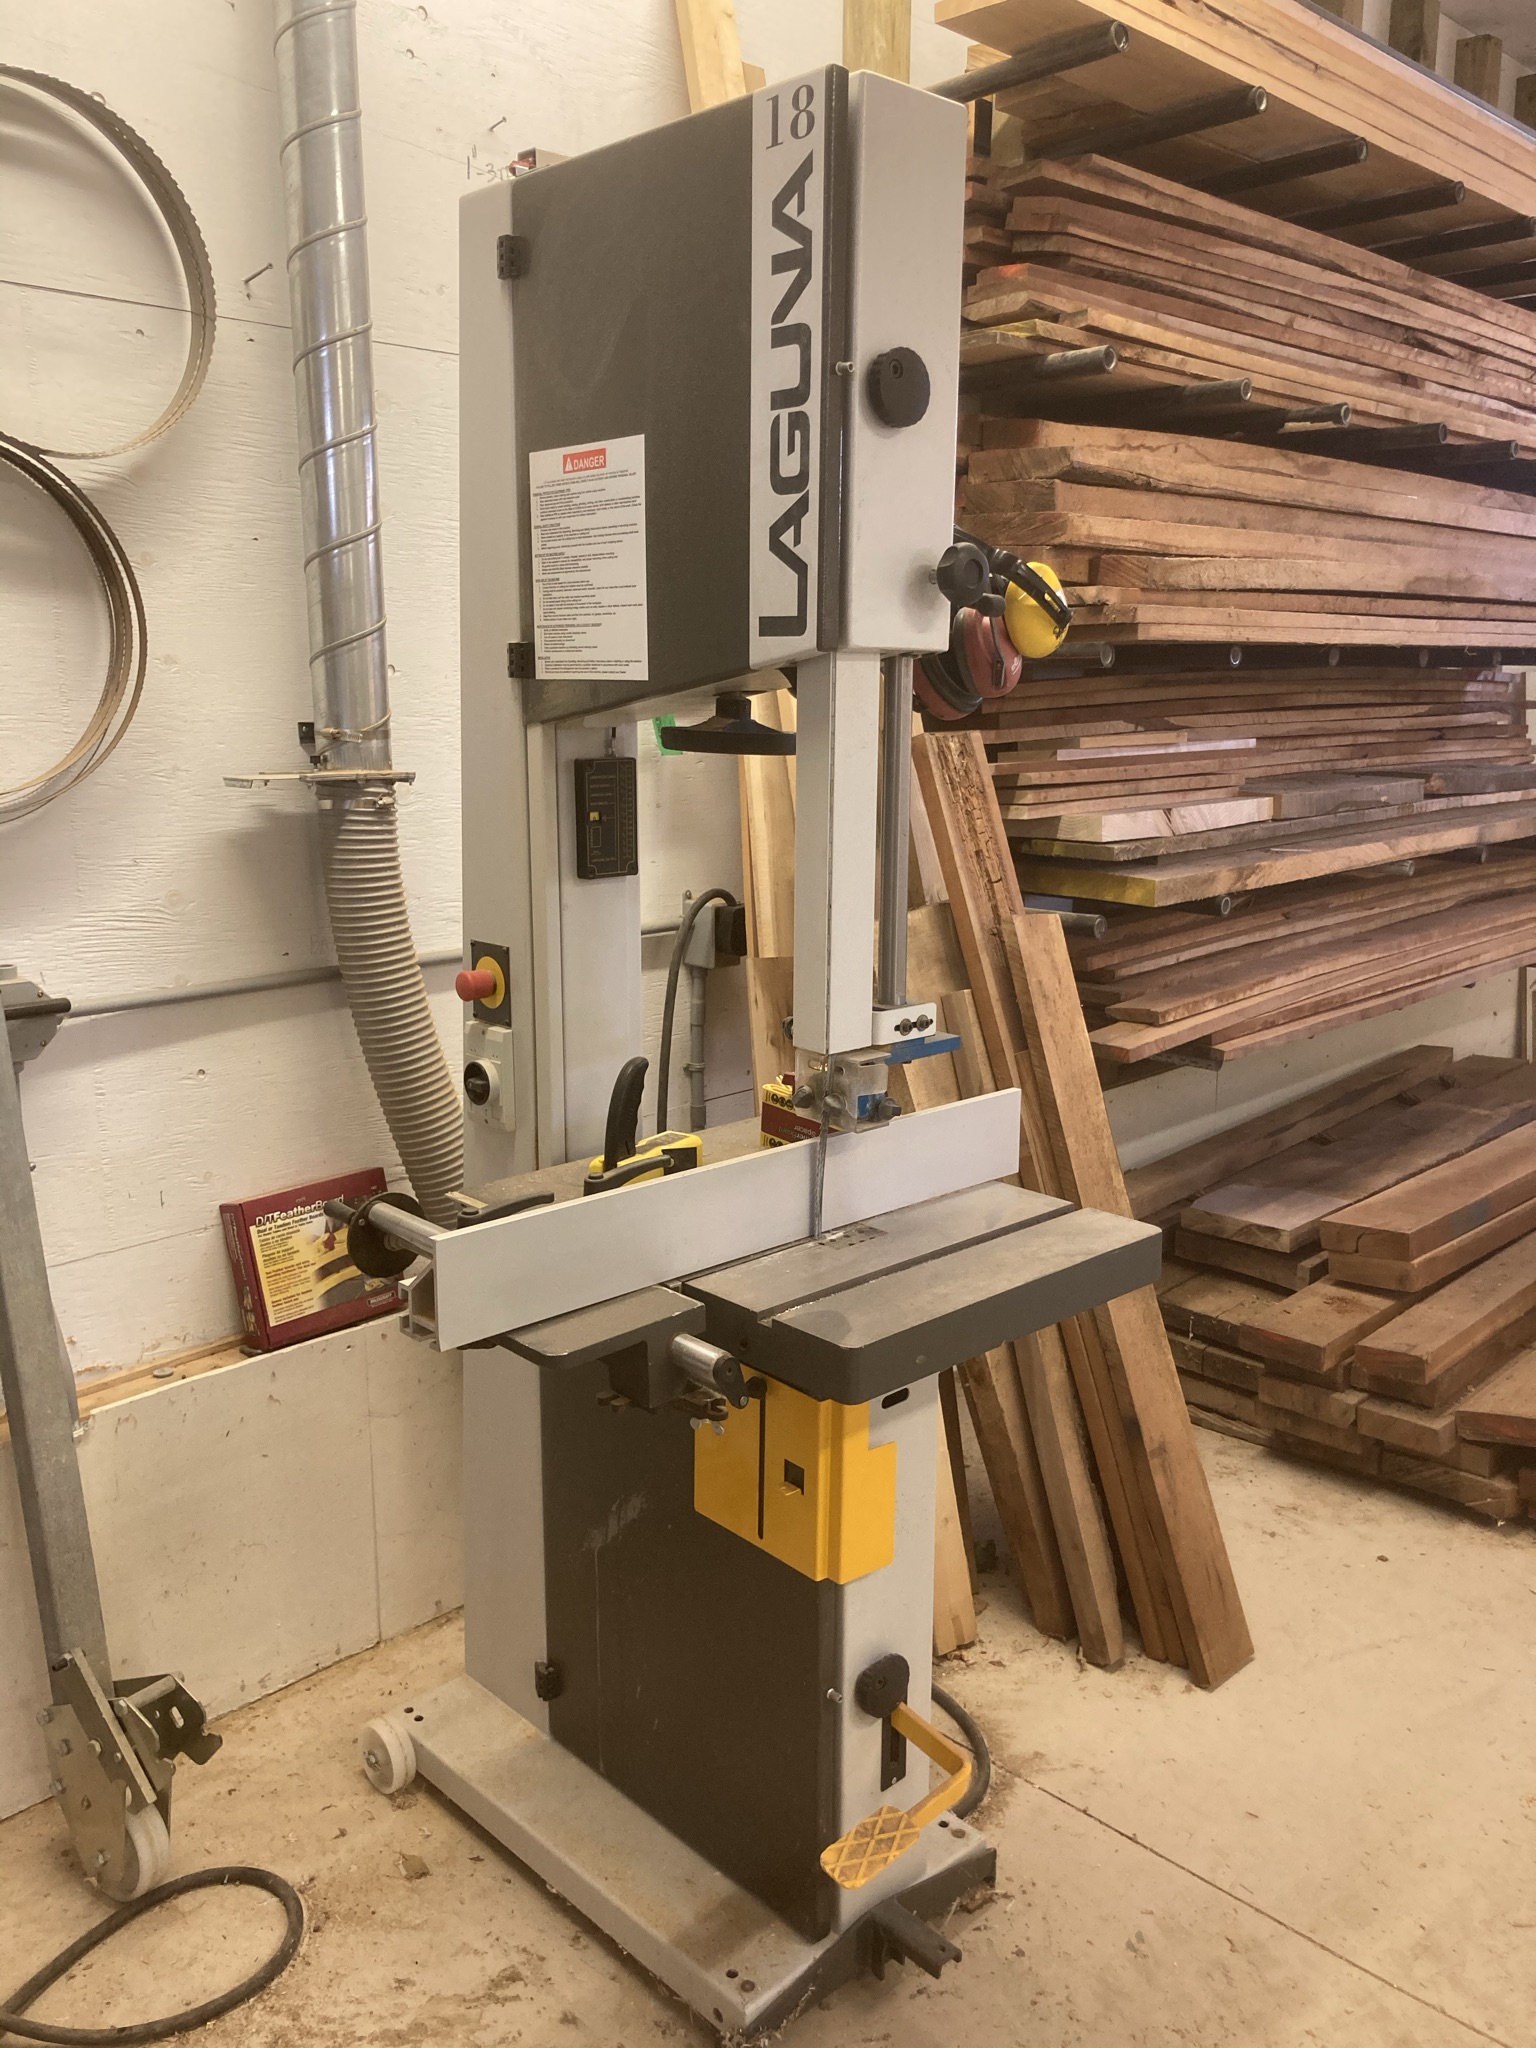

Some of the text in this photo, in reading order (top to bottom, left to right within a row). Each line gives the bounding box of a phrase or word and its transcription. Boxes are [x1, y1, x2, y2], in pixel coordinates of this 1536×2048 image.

[765, 84, 815, 150] 18
[758, 148, 814, 638] LAGUNA
[573, 455, 605, 471] DANGER
[793, 1124, 817, 1138] Spacer
[255, 1193, 344, 1228] D/TFeatherBd
